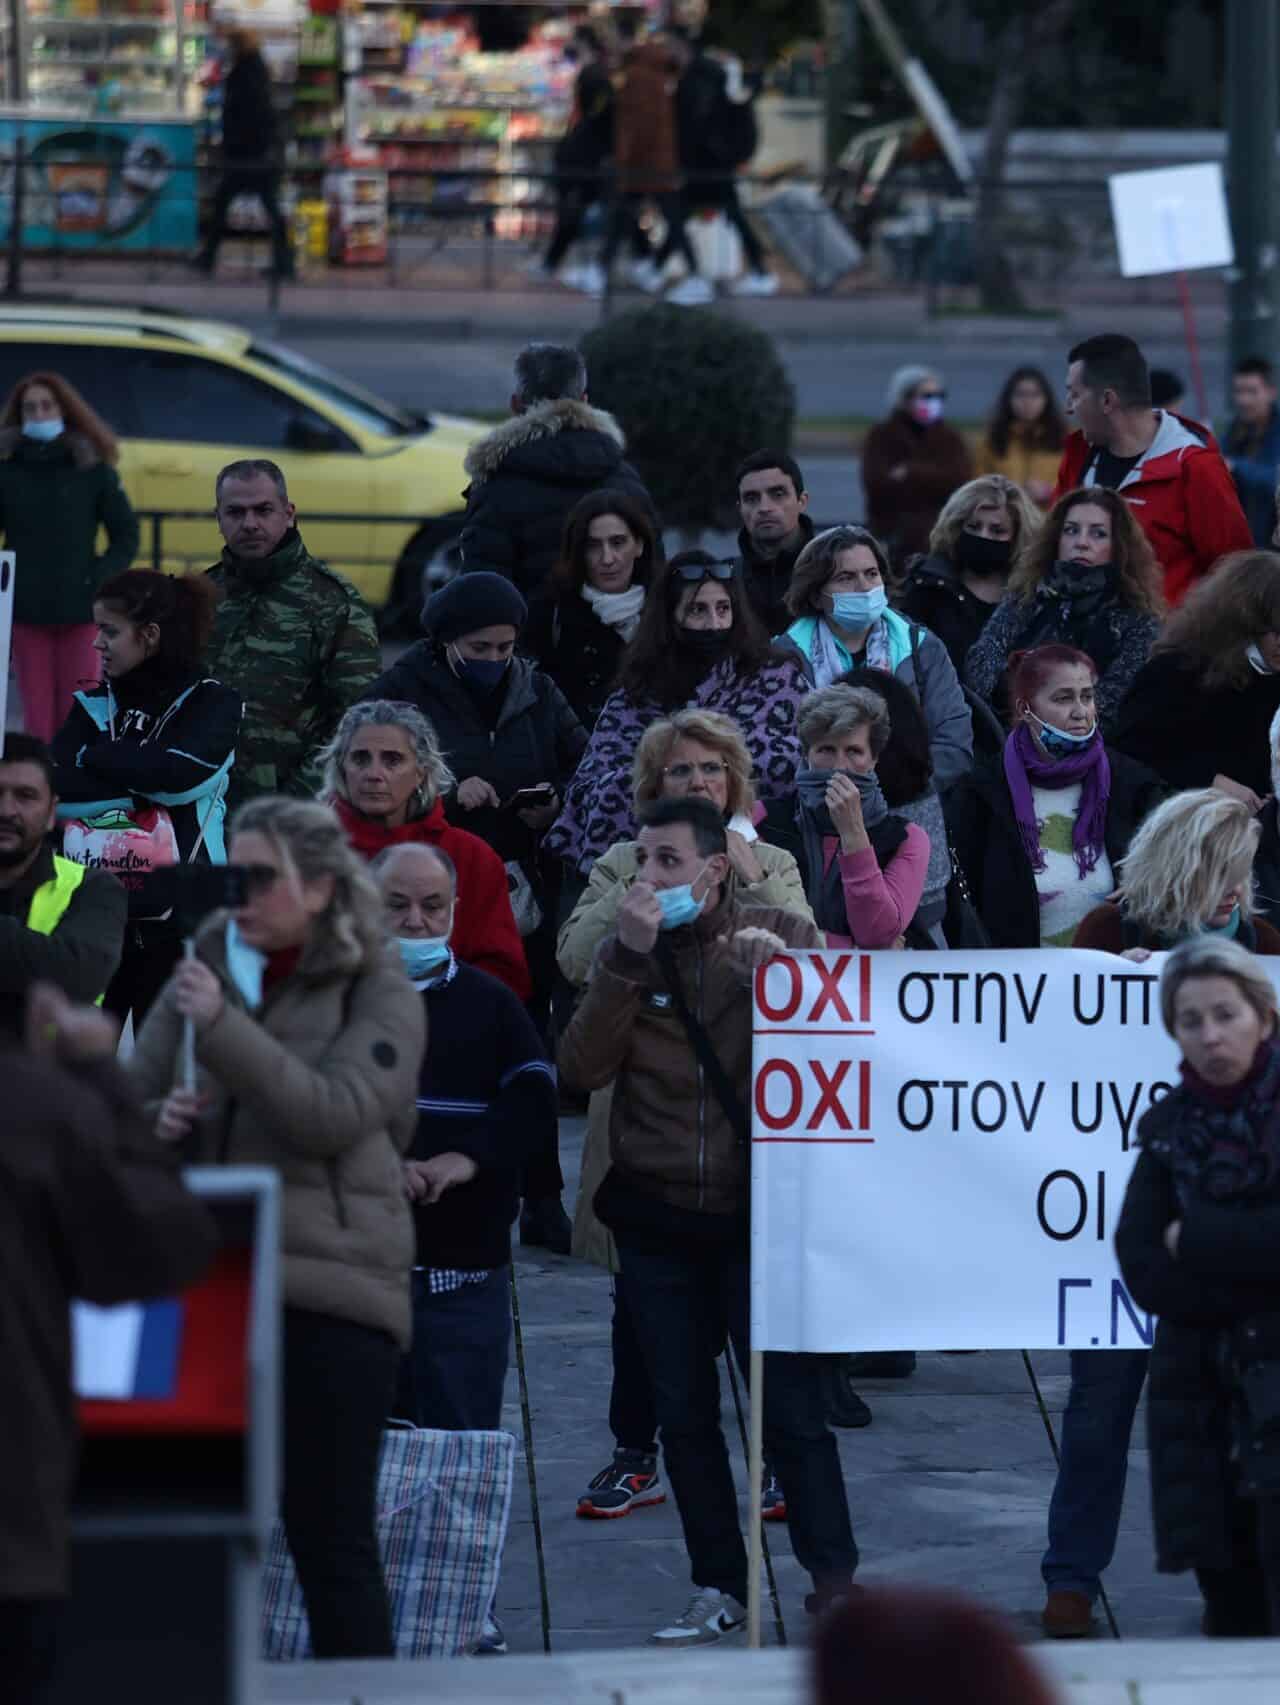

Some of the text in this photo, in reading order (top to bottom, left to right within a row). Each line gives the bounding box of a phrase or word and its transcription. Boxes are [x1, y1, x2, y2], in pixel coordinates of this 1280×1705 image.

[66, 847, 151, 869] Wtermelon
[755, 953, 871, 1022] ΟΧΙ
[898, 971, 1046, 1043] στην
[755, 1059, 871, 1131] ΟΧΙ
[898, 1079, 1046, 1132] στον
[1036, 1169, 1105, 1242] ΟΙ
